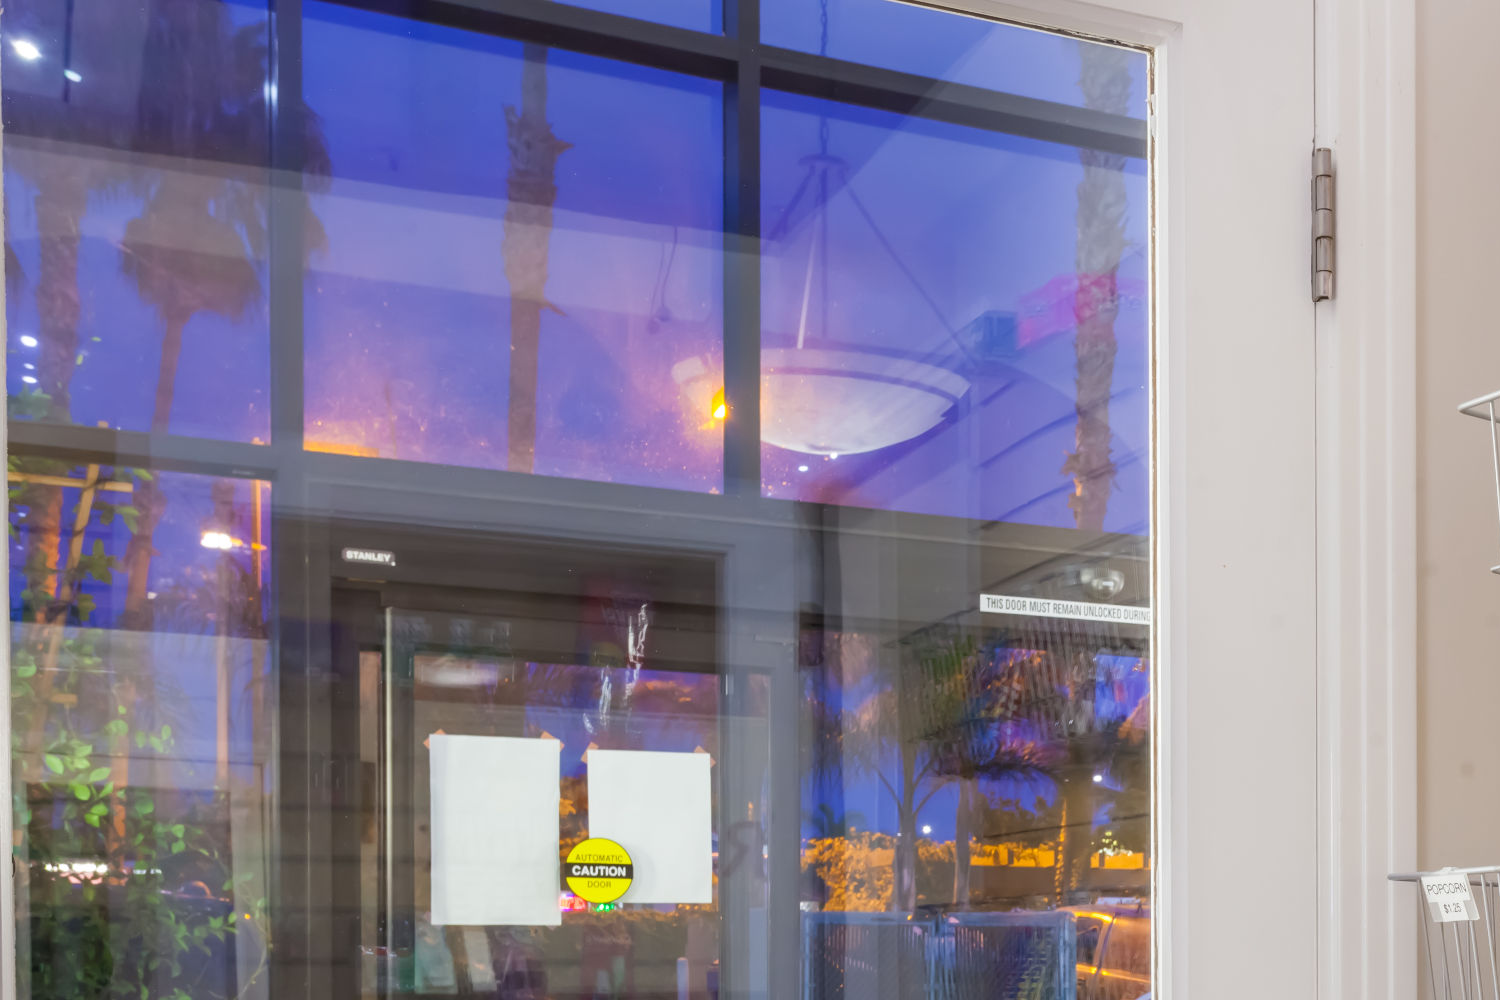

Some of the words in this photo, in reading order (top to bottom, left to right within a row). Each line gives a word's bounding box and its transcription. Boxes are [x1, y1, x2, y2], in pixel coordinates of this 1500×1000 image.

[346, 550, 391, 562] STANLEY
[986, 597, 1003, 609] THIS
[1005, 599, 1027, 610] DOOR
[1029, 601, 1051, 613] MUST
[1053, 603, 1082, 616] REMAIN
[1083, 606, 1122, 619] UNLOCKED
[576, 853, 623, 863] AUTOMATIC
[571, 865, 627, 877] CAUTION
[587, 880, 612, 888] DOOR
[1427, 882, 1467, 895] POPCORN
[1444, 902, 1463, 914] $1.25
